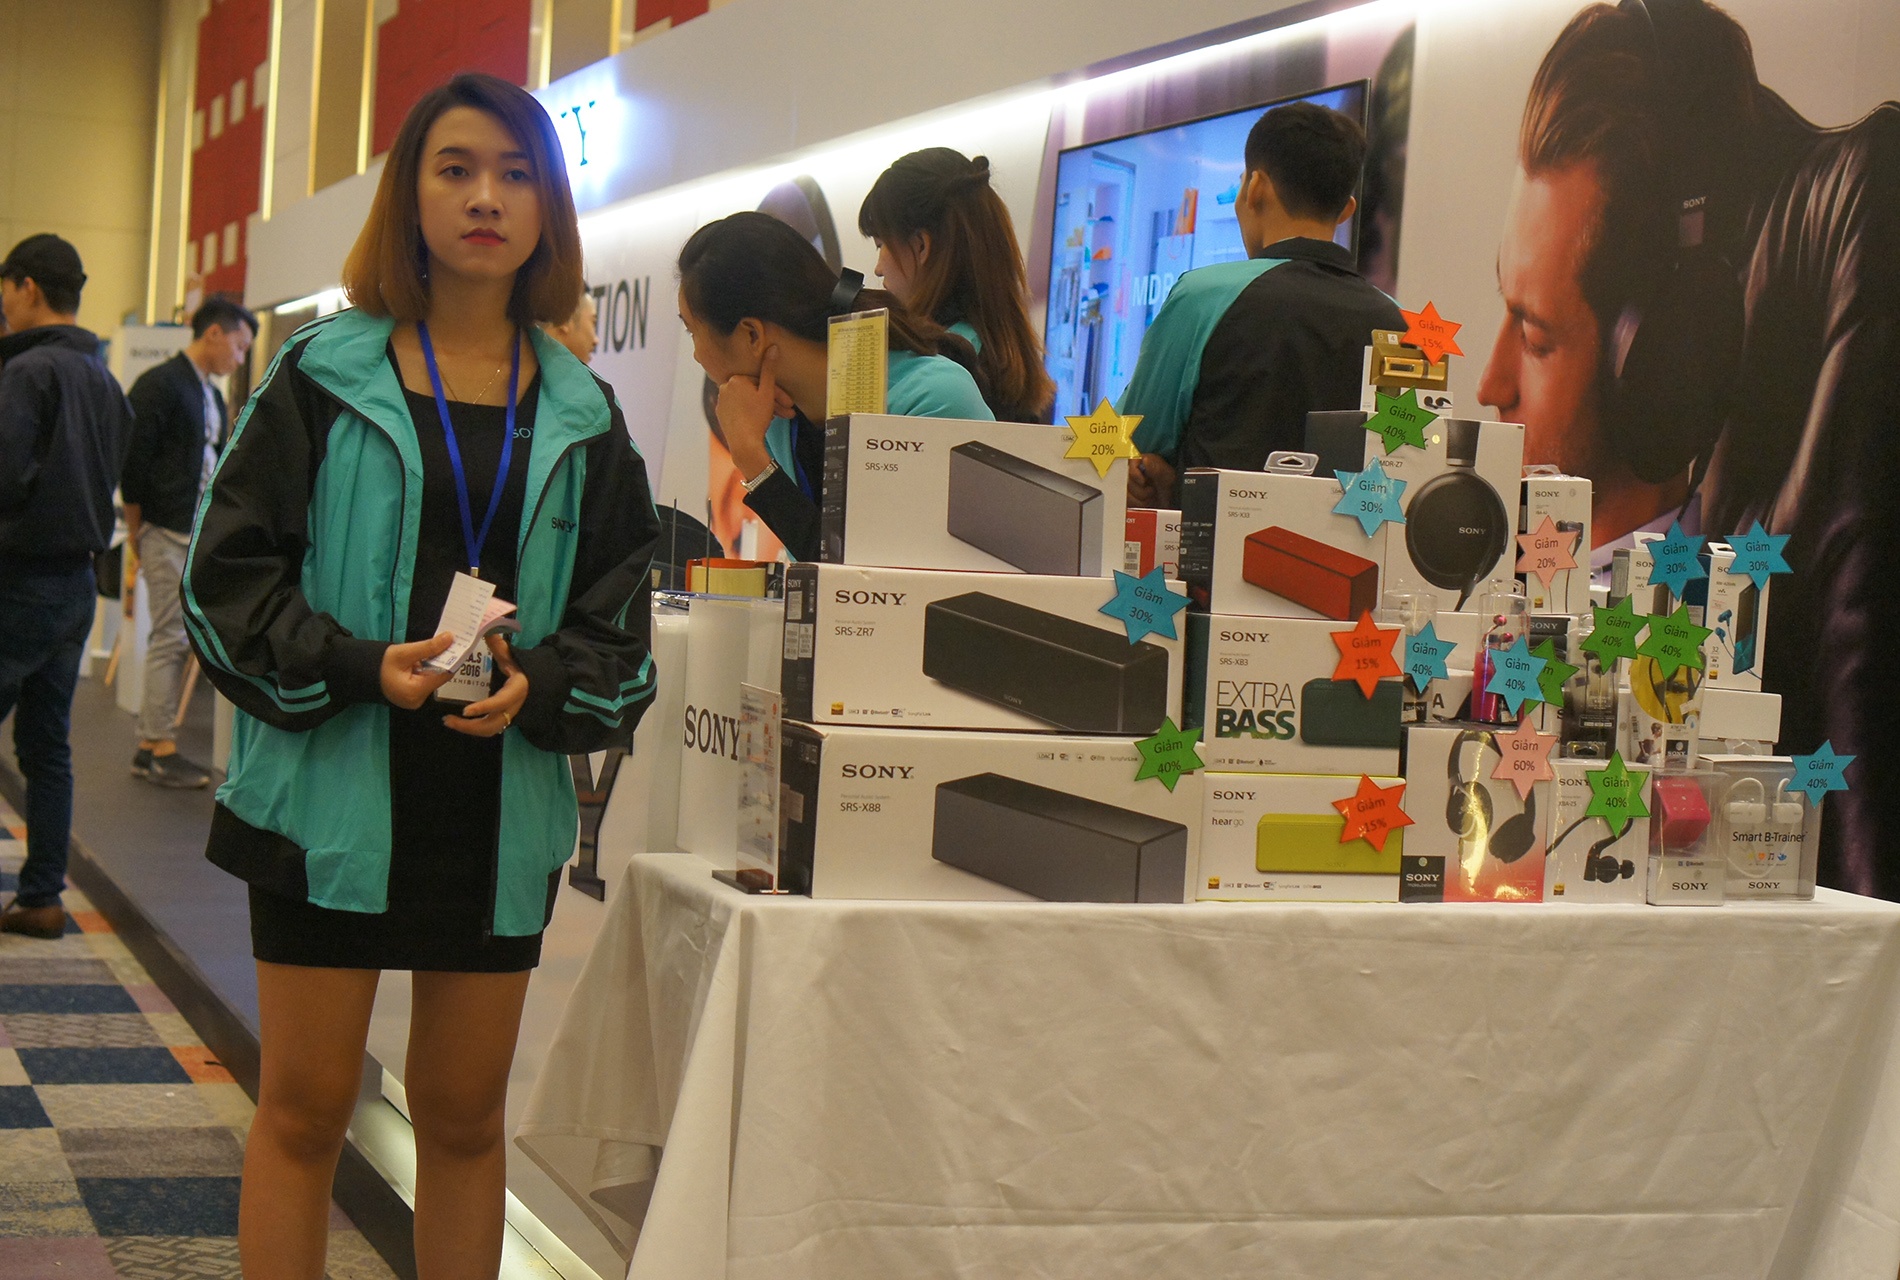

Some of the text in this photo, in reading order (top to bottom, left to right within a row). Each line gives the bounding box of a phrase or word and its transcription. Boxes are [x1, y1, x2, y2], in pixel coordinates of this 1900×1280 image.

[1683, 196, 1706, 209] SONY
[1418, 319, 1445, 333] Giảm
[1422, 337, 1444, 350] 15%
[1389, 405, 1416, 422] Giảm
[1089, 422, 1118, 434] Giảm
[1384, 425, 1406, 441] 40%
[866, 438, 924, 452] SONY
[1091, 444, 1115, 455] 20%
[865, 462, 899, 472] SRS-X55
[1359, 480, 1387, 494] Giảm
[1229, 489, 1268, 499] SONY
[1360, 501, 1383, 513] 30%
[1534, 537, 1559, 549] Giảm
[1662, 543, 1688, 555] Giảm
[1745, 541, 1771, 552] Giảm
[1536, 557, 1556, 568] 20%
[1666, 563, 1687, 574] 30%
[1749, 561, 1770, 571] 30%
[835, 590, 906, 605] SONY
[1134, 586, 1164, 605] Giảm
[1129, 607, 1154, 624] 30%
[1605, 615, 1631, 629] Giảm
[834, 626, 875, 636] SRS-ZR7
[1220, 631, 1269, 642] SONY
[1664, 624, 1689, 639] Giảm
[1352, 635, 1381, 648] Giảm
[1601, 635, 1622, 647] 40%
[1412, 642, 1438, 655] Giảm
[1661, 644, 1682, 658] 40%
[1219, 658, 1249, 666] SRS-XB3
[1356, 658, 1380, 670] 15%
[1505, 657, 1530, 671] Giảm
[460, 664, 481, 677] 2016
[1411, 663, 1433, 676] 40%
[1505, 678, 1526, 691] 40%
[1003, 694, 1023, 705] SONY
[1217, 680, 1296, 709] EXTRA
[1215, 707, 1296, 740] BASS
[684, 705, 740, 761] SONY
[1153, 739, 1183, 754] Giảm
[1511, 738, 1539, 751] Giảm
[1157, 760, 1182, 774] 40%
[1513, 759, 1535, 771] 60%
[1808, 759, 1834, 770] Giảm
[842, 764, 914, 779] SONY
[1602, 775, 1630, 788] Giảm
[1807, 778, 1828, 789] 40%
[1213, 791, 1256, 800] SONY
[840, 802, 881, 812] SRS-X88
[1357, 797, 1386, 813] Giảm
[1605, 797, 1628, 808] 40%
[1233, 818, 1244, 827] go
[1363, 818, 1387, 833] 15%
[1732, 831, 1806, 842] Smart B-Trainer
[1406, 874, 1440, 882] SONY
[1672, 882, 1708, 890] SONY
[1748, 881, 1780, 889] SONY
